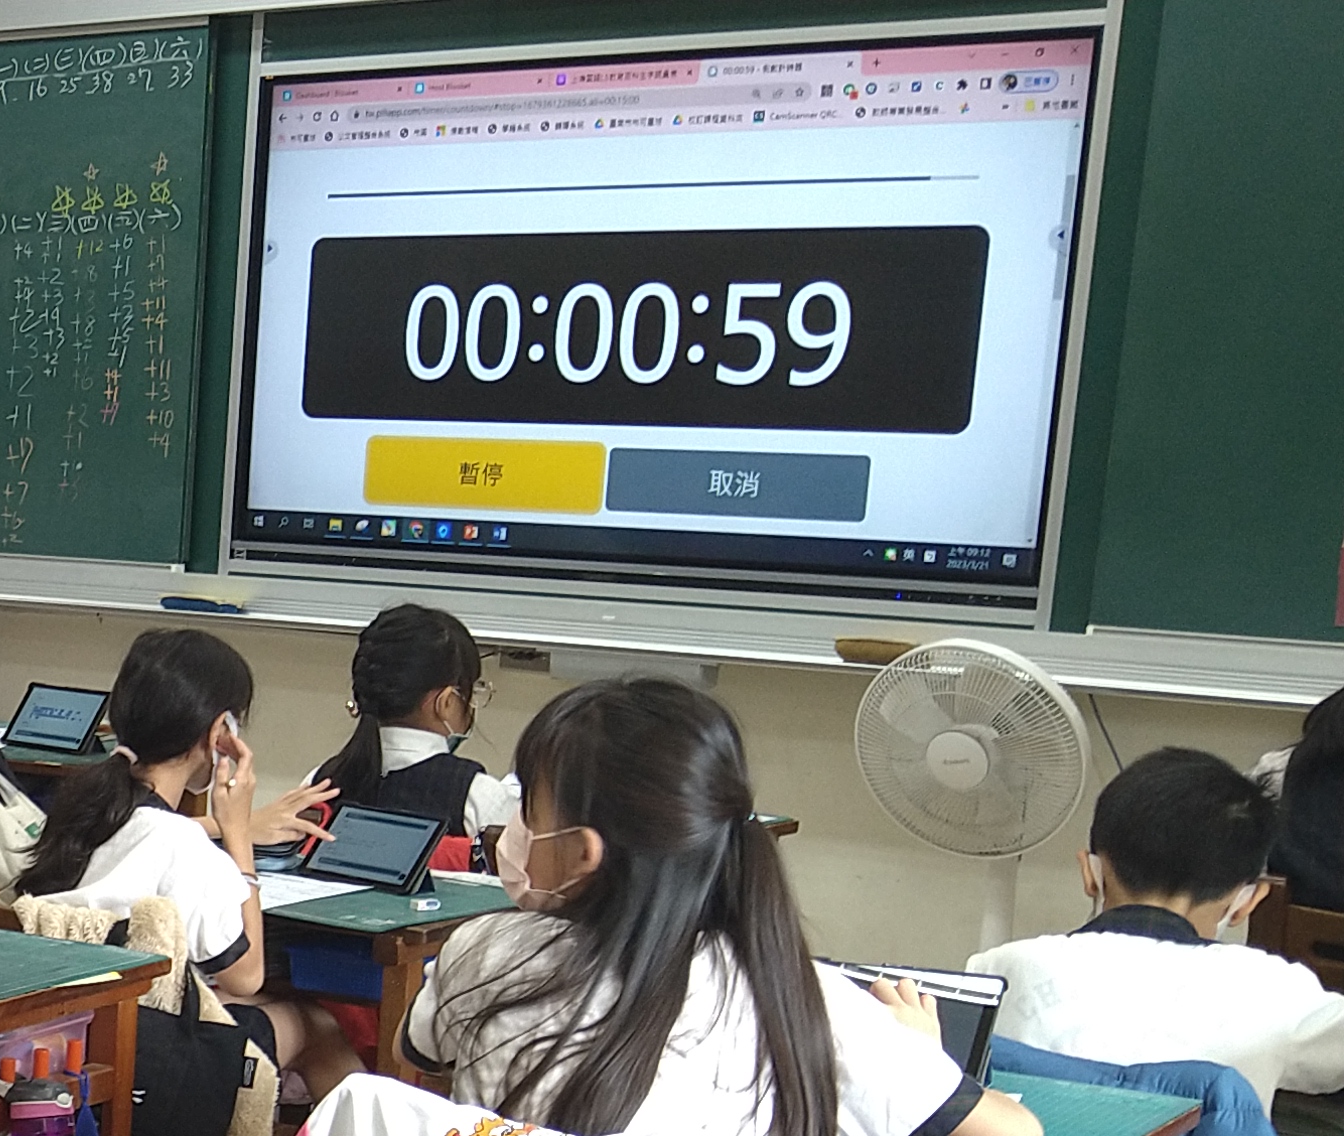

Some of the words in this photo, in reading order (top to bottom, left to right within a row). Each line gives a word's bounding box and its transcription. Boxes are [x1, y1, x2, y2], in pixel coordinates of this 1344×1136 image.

[29, 78, 48, 101] 16
[59, 76, 82, 94] 25
[86, 70, 113, 95] 38
[167, 61, 194, 89] 33
[76, 239, 104, 260] +12
[109, 234, 133, 253] +6
[38, 268, 65, 286] +2
[405, 281, 852, 387] 00:00:59
[6, 365, 34, 397] +2
[145, 381, 170, 402] +3
[146, 408, 174, 429] +10
[459, 462, 504, 488] 暫停
[708, 469, 761, 498] 取消
